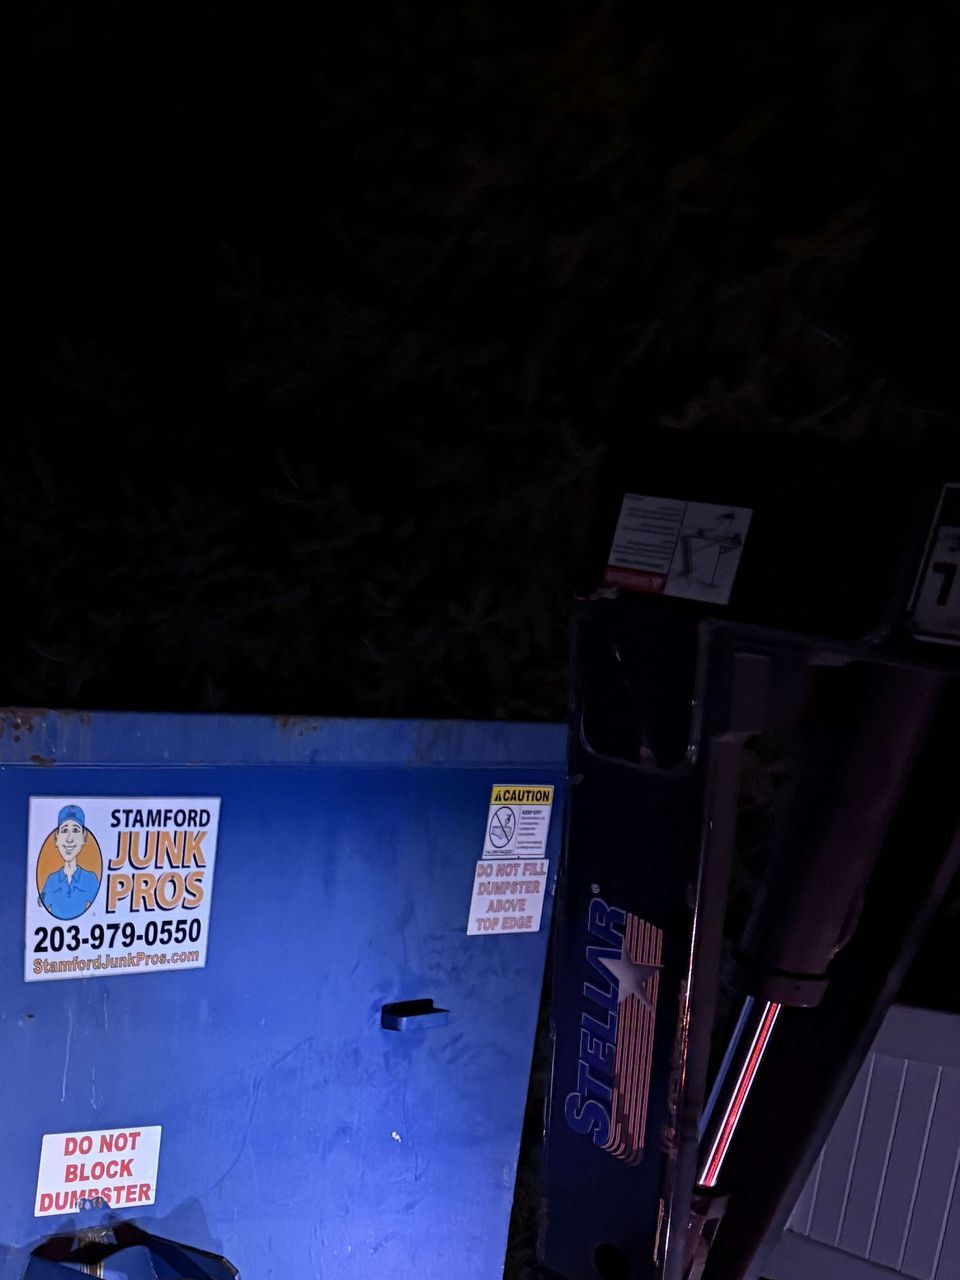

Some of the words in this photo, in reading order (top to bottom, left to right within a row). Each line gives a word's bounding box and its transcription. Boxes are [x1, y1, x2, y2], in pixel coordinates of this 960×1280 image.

[503, 789, 550, 802] CAUTION
[110, 809, 211, 828] STAMFORD
[107, 831, 208, 871] JUNK
[477, 863, 493, 878] DO
[496, 863, 521, 877] NOT
[522, 862, 546, 876] FILL
[105, 871, 205, 914] PROS
[477, 880, 540, 896] DUMPSTER
[486, 898, 526, 914] ABOVE
[33, 918, 202, 953] 203-979-0550
[476, 917, 499, 931] TOP
[501, 916, 533, 930] EDGE
[33, 950, 199, 975] StamfordJunkPros.com
[564, 897, 627, 1146] STELLAR
[64, 1136, 93, 1156] DO
[99, 1132, 141, 1153] NOT
[64, 1158, 134, 1183] BLOCK
